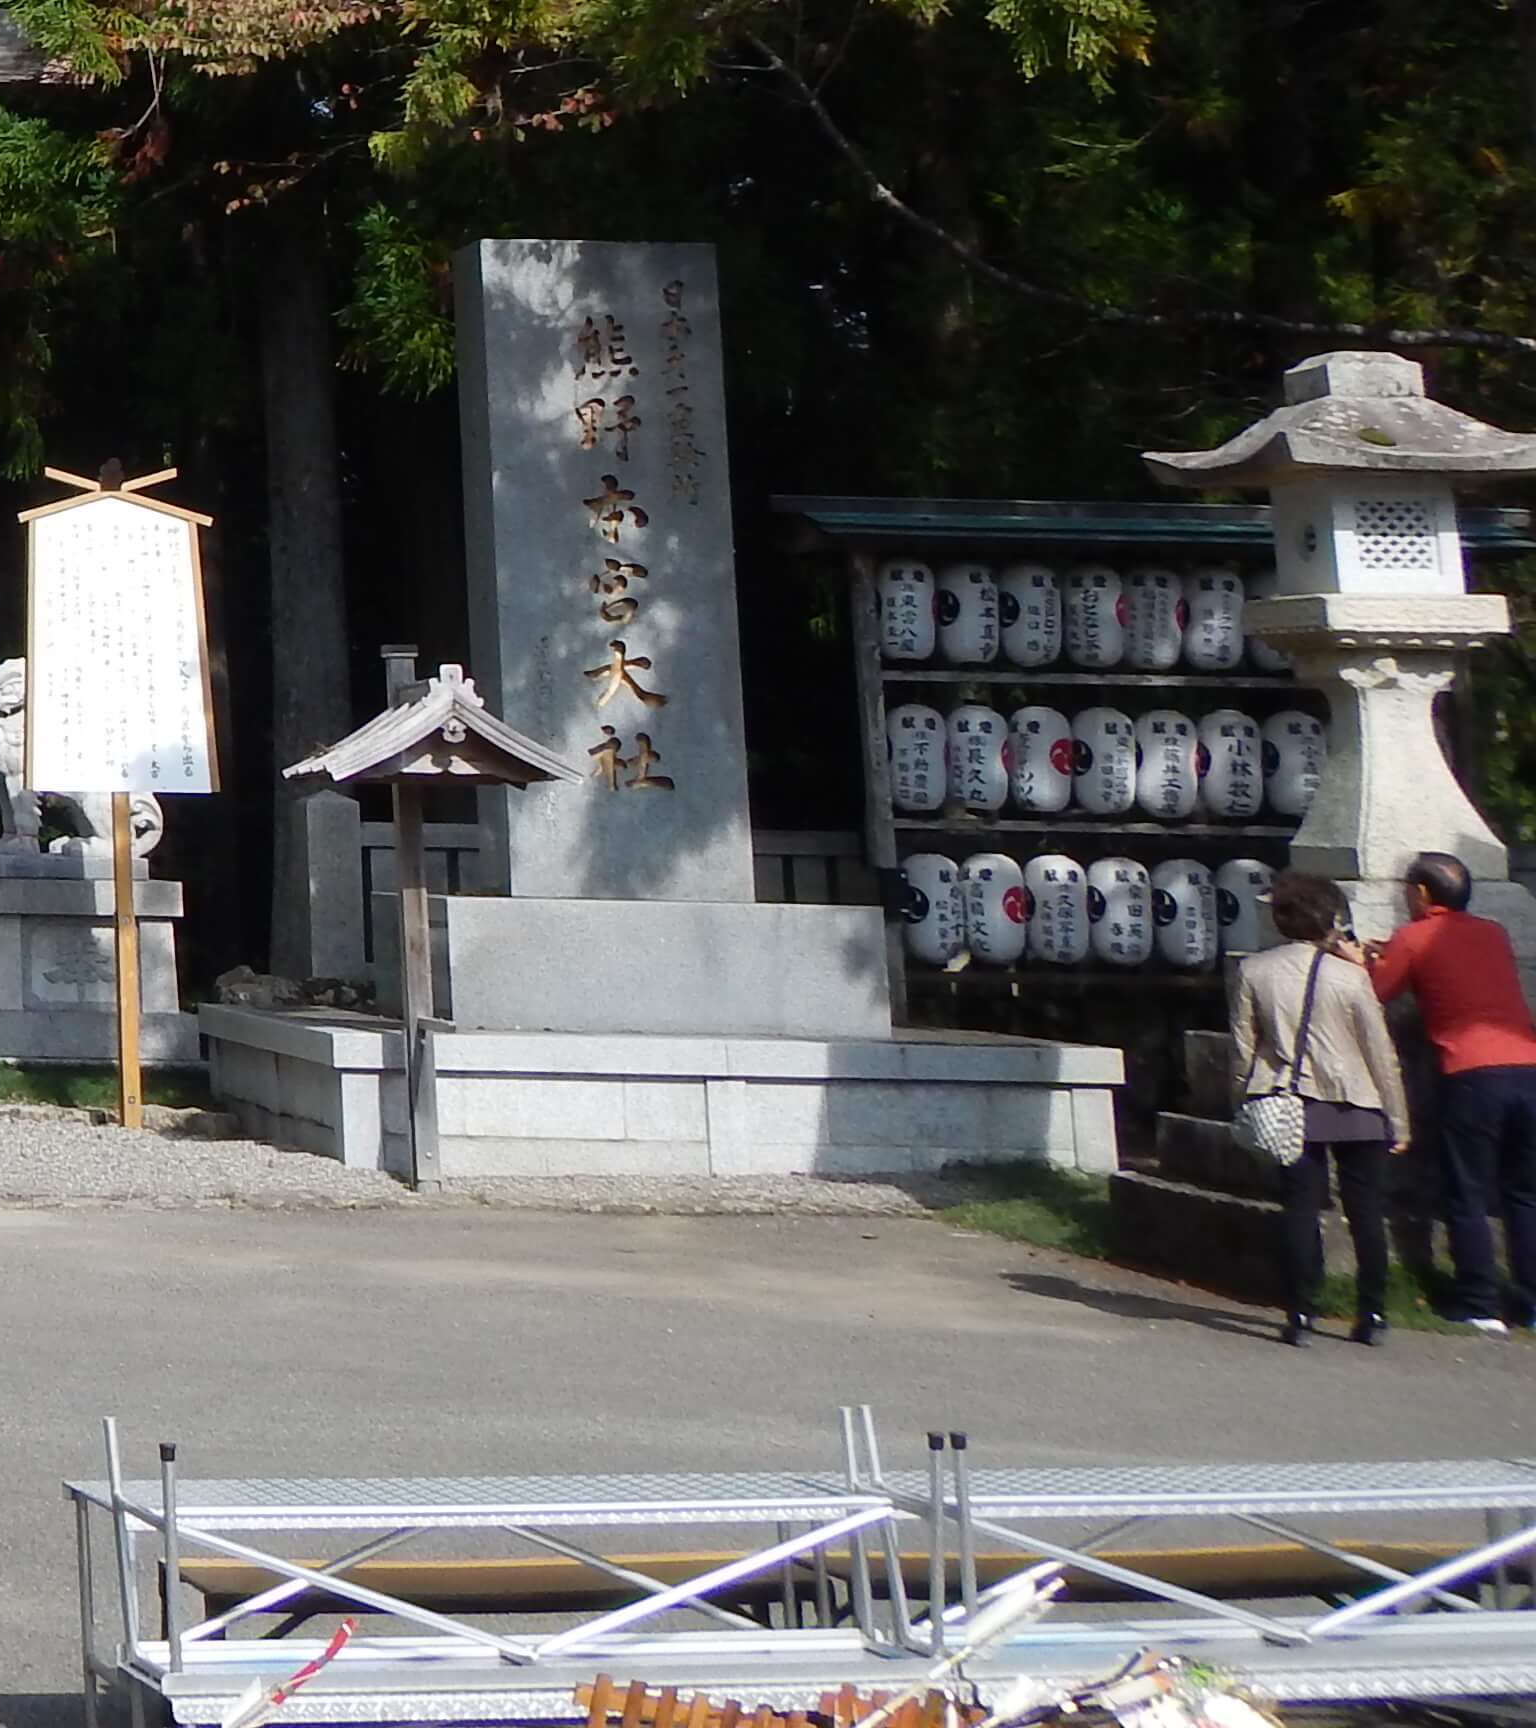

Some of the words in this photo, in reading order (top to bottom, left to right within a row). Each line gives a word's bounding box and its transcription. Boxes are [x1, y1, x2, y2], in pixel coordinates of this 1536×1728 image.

[574, 313, 676, 792] 熊野本宮大社
